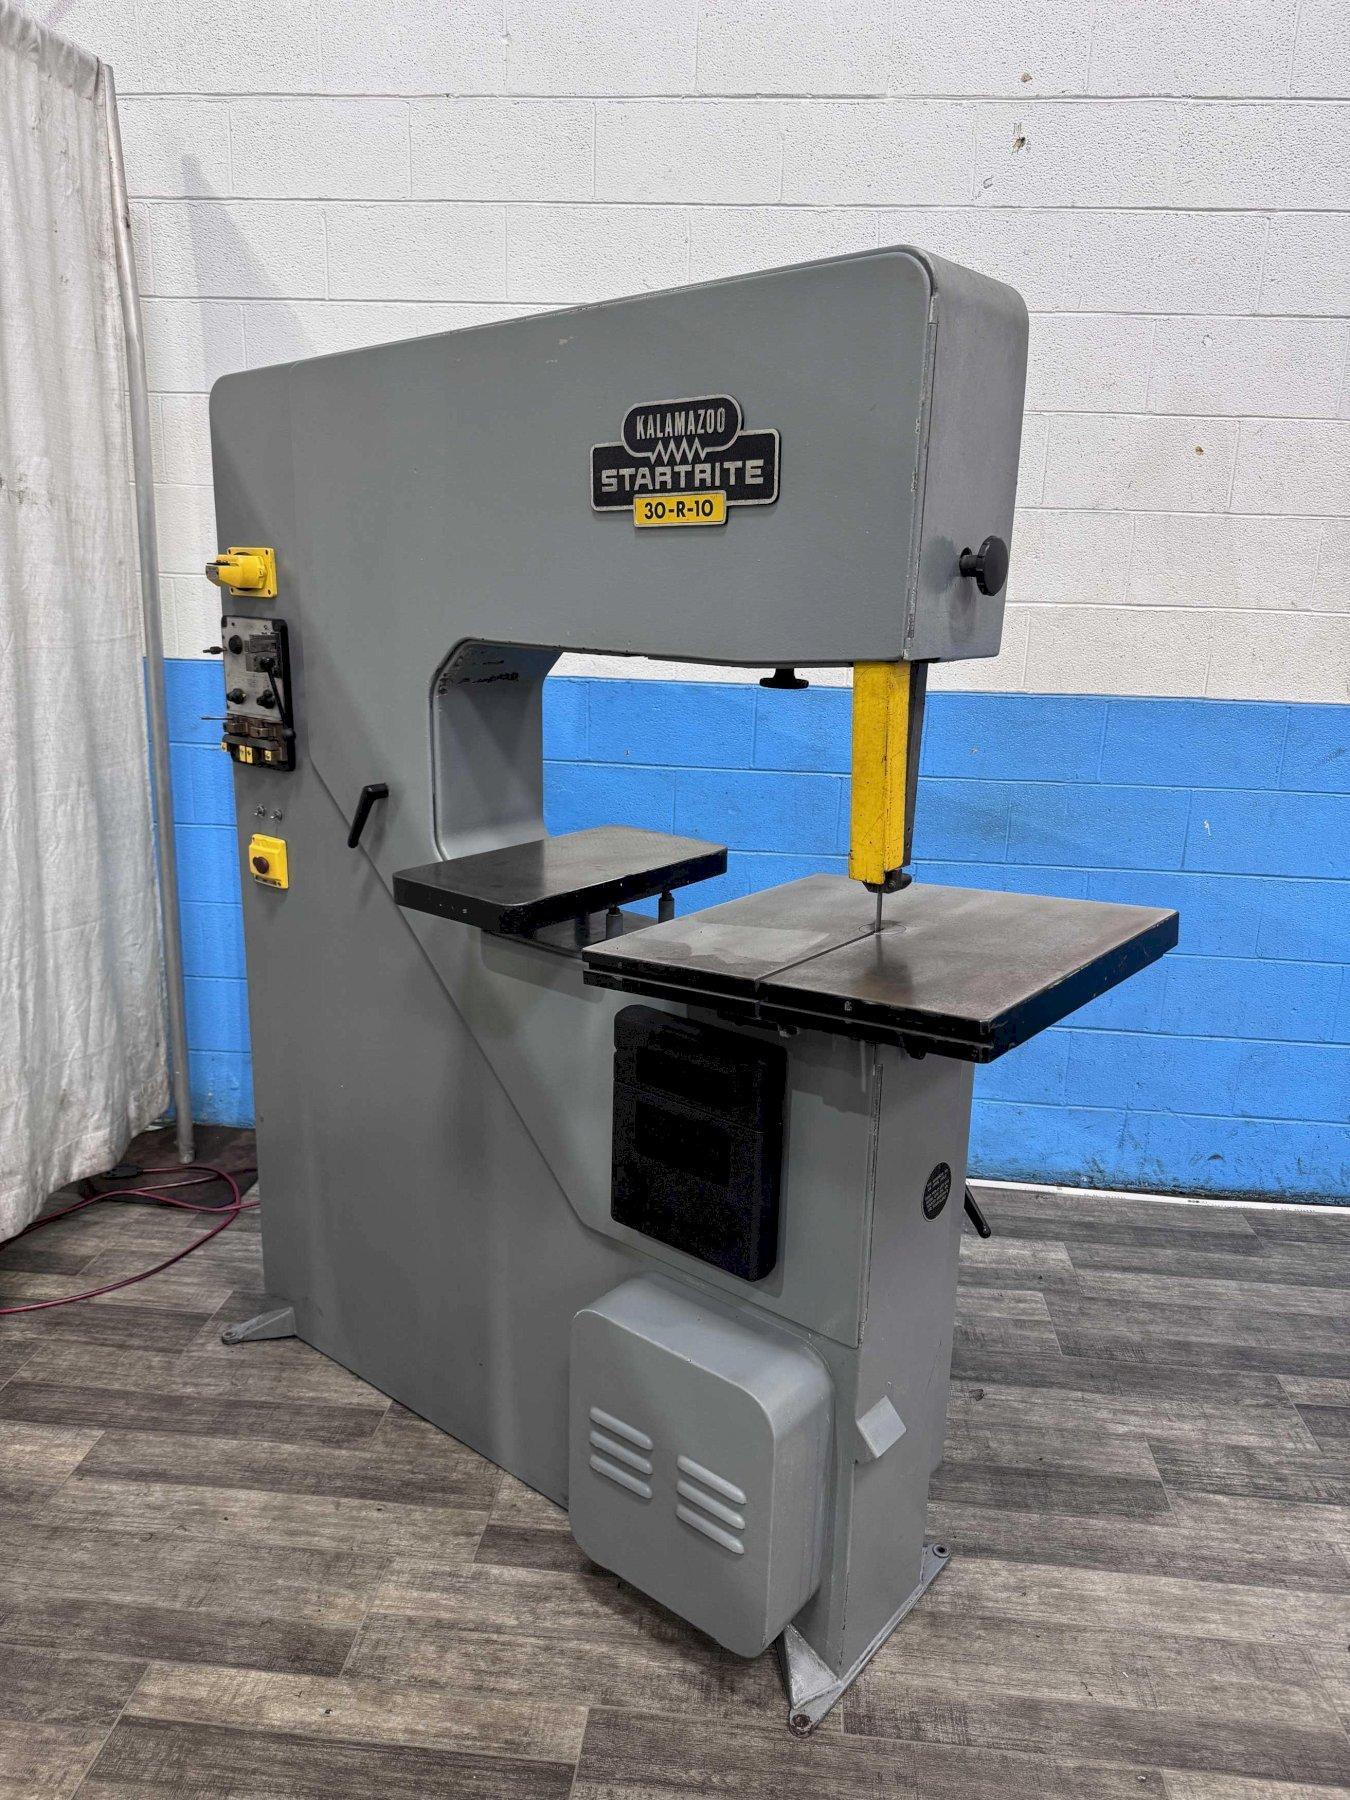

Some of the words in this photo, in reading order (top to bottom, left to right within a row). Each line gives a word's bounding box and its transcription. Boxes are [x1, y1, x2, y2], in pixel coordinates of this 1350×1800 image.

[636, 407, 726, 439] KALAMAZOO
[601, 459, 764, 492] STARTRITE
[644, 499, 714, 519] 30-R-10
